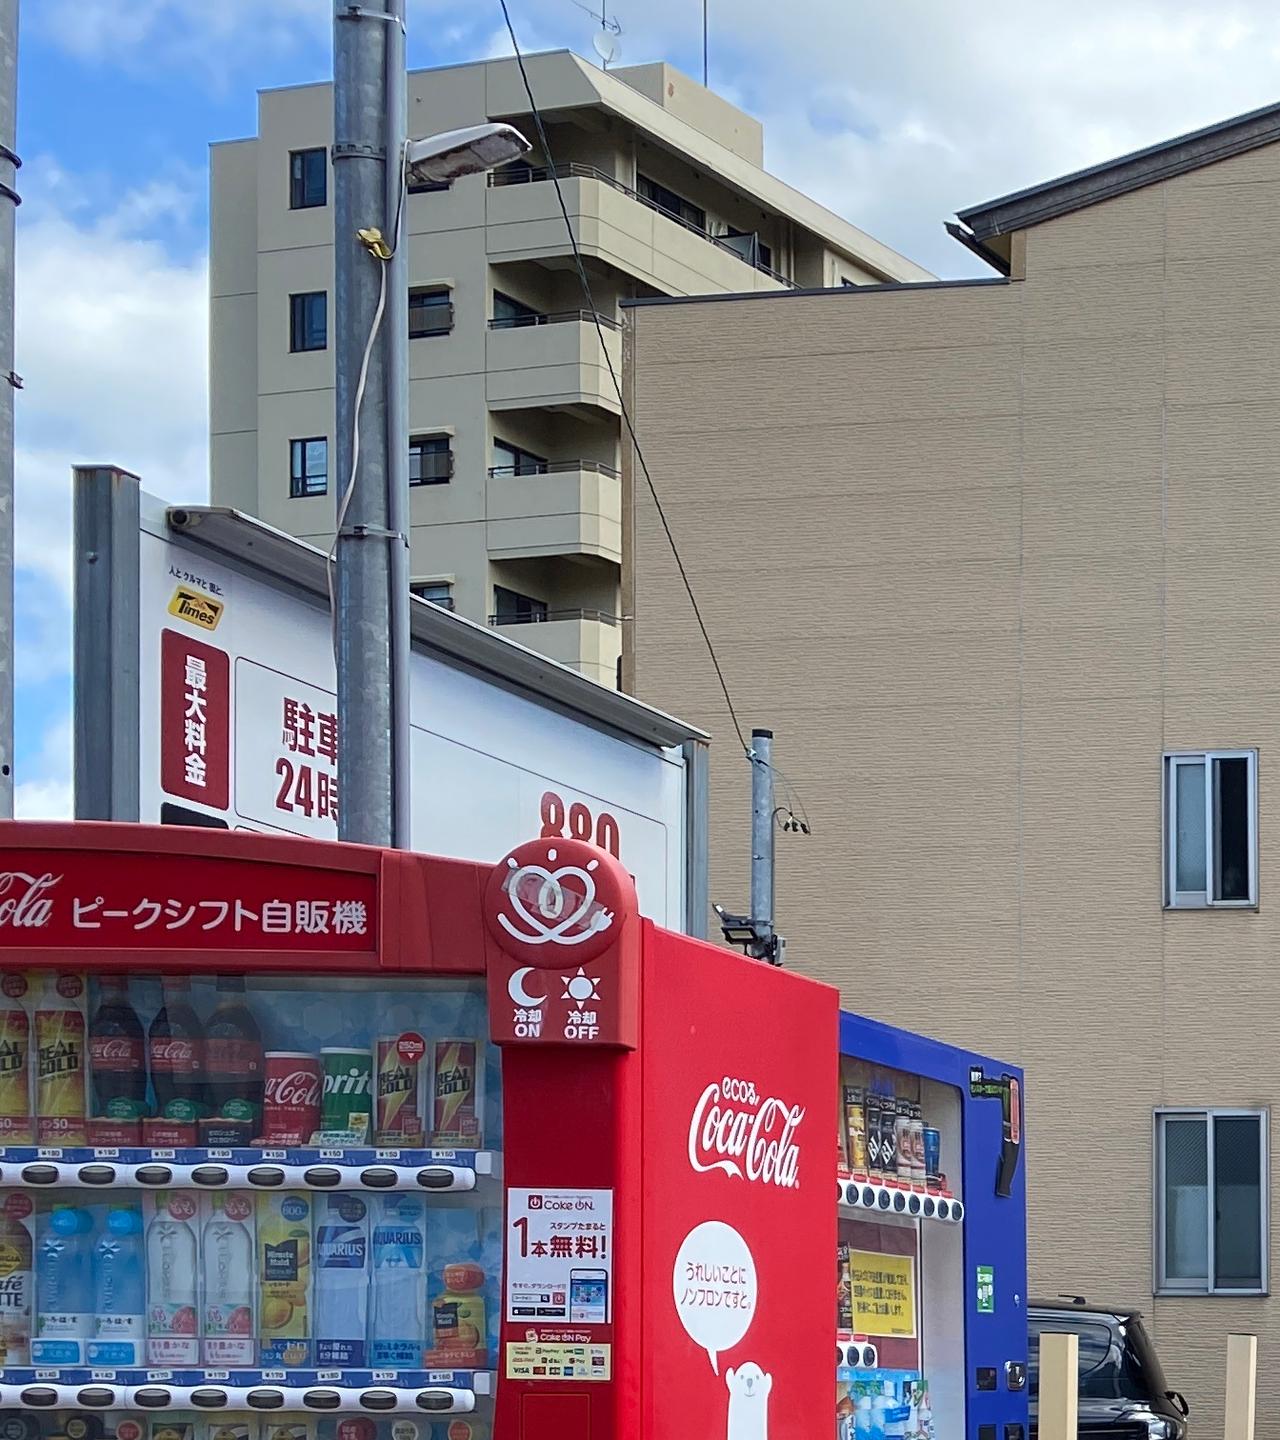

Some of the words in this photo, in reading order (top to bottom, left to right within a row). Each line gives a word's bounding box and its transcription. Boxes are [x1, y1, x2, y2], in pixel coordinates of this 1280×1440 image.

[176, 592, 219, 625] Times
[184, 654, 208, 788] 最大料金
[73, 896, 367, 935] ピークシフト自販機
[513, 1009, 542, 1022] 冷却
[567, 1011, 597, 1025] 冷却
[514, 1024, 540, 1038] ON
[564, 1025, 600, 1039] OFF
[379, 1065, 411, 1083] REAL
[436, 1065, 468, 1082] REAL
[379, 1079, 412, 1097] GOLD
[437, 1080, 469, 1097] GOLD
[689, 1083, 806, 1189] Coca-Cola
[544, 1201, 573, 1210] Coke
[686, 1262, 746, 1285] うれしいことに
[681, 1290, 752, 1310] ノンフロンですと。
[540, 1332, 560, 1341] Coke
[576, 1333, 591, 1343] Pay
